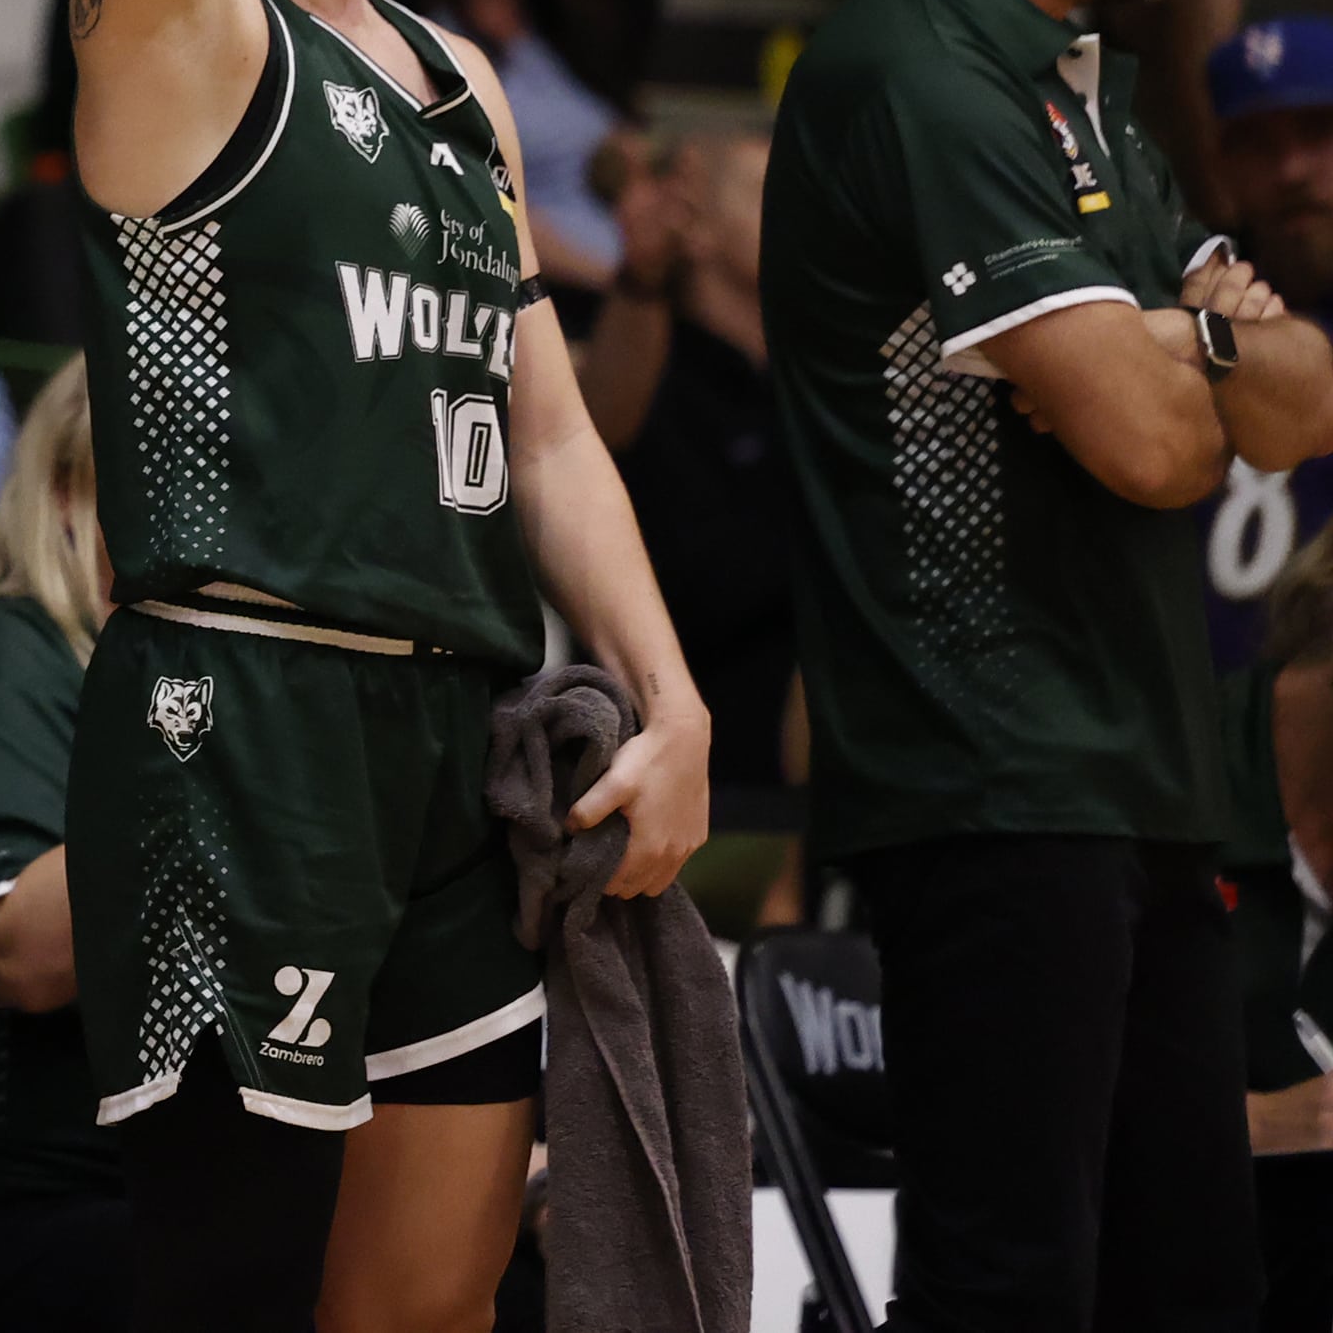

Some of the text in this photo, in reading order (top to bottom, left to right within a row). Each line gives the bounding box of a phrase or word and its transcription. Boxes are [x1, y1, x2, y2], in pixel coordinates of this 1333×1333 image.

[469, 220, 488, 247] of
[430, 387, 509, 517] 10
[258, 1041, 325, 1067] Zambrero
